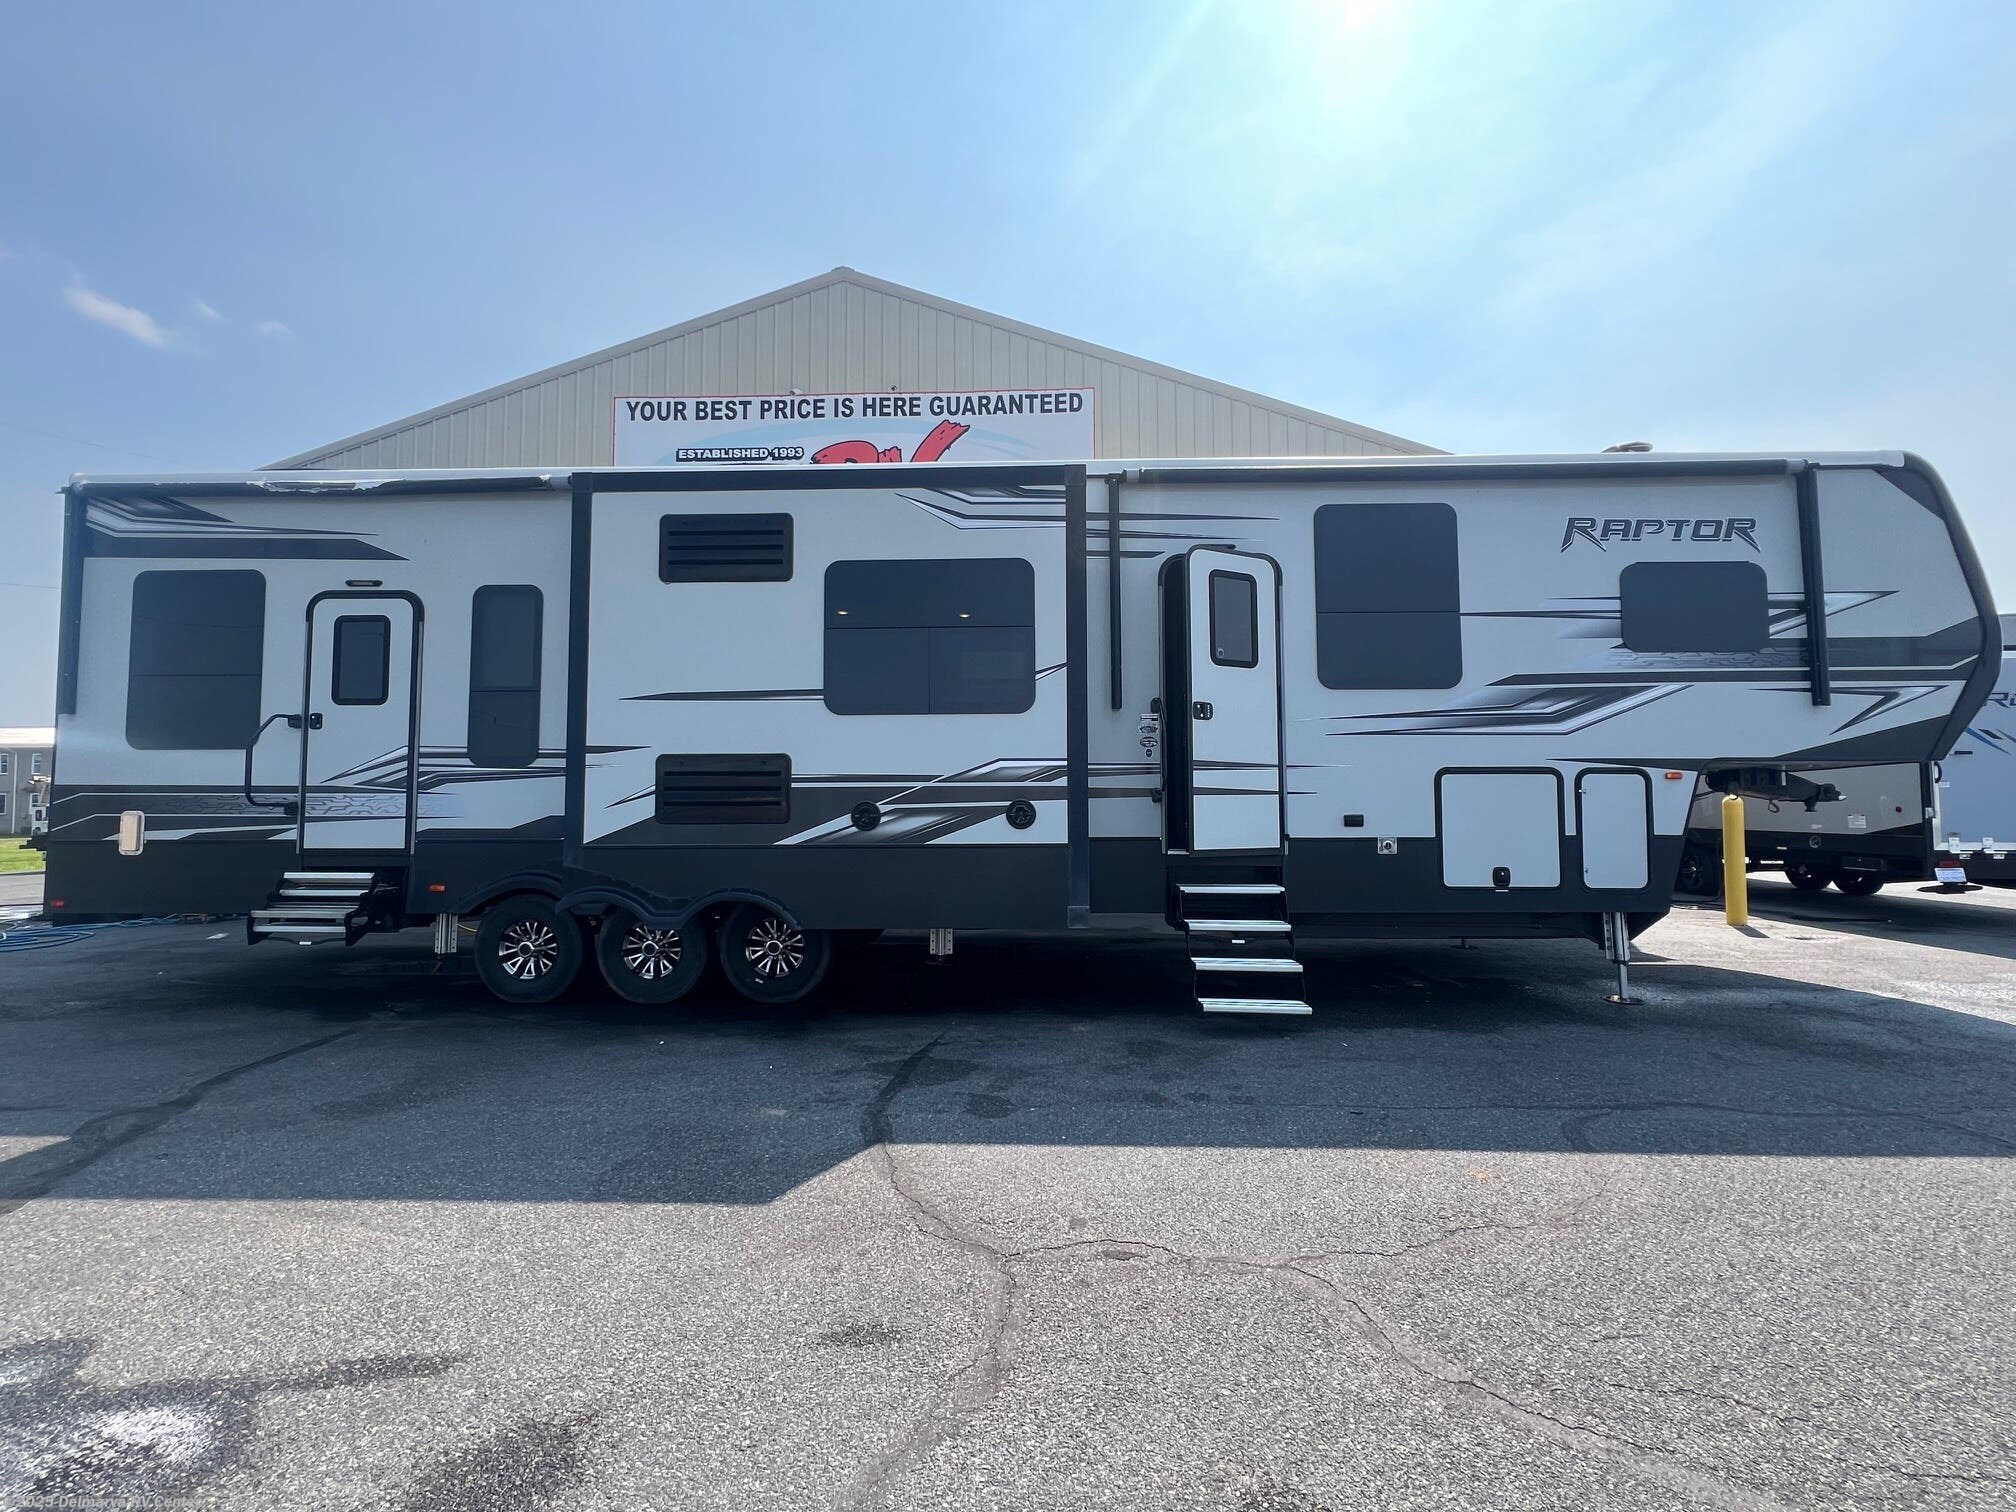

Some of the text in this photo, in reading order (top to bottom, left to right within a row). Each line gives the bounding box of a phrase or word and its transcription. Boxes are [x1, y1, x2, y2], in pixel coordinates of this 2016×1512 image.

[626, 392, 1083, 421] YOUR BEST PRICE IS HERE GUARANTEED
[677, 447, 804, 460] ESTABLISHED 1993
[1561, 517, 1761, 552] RAPTOR
